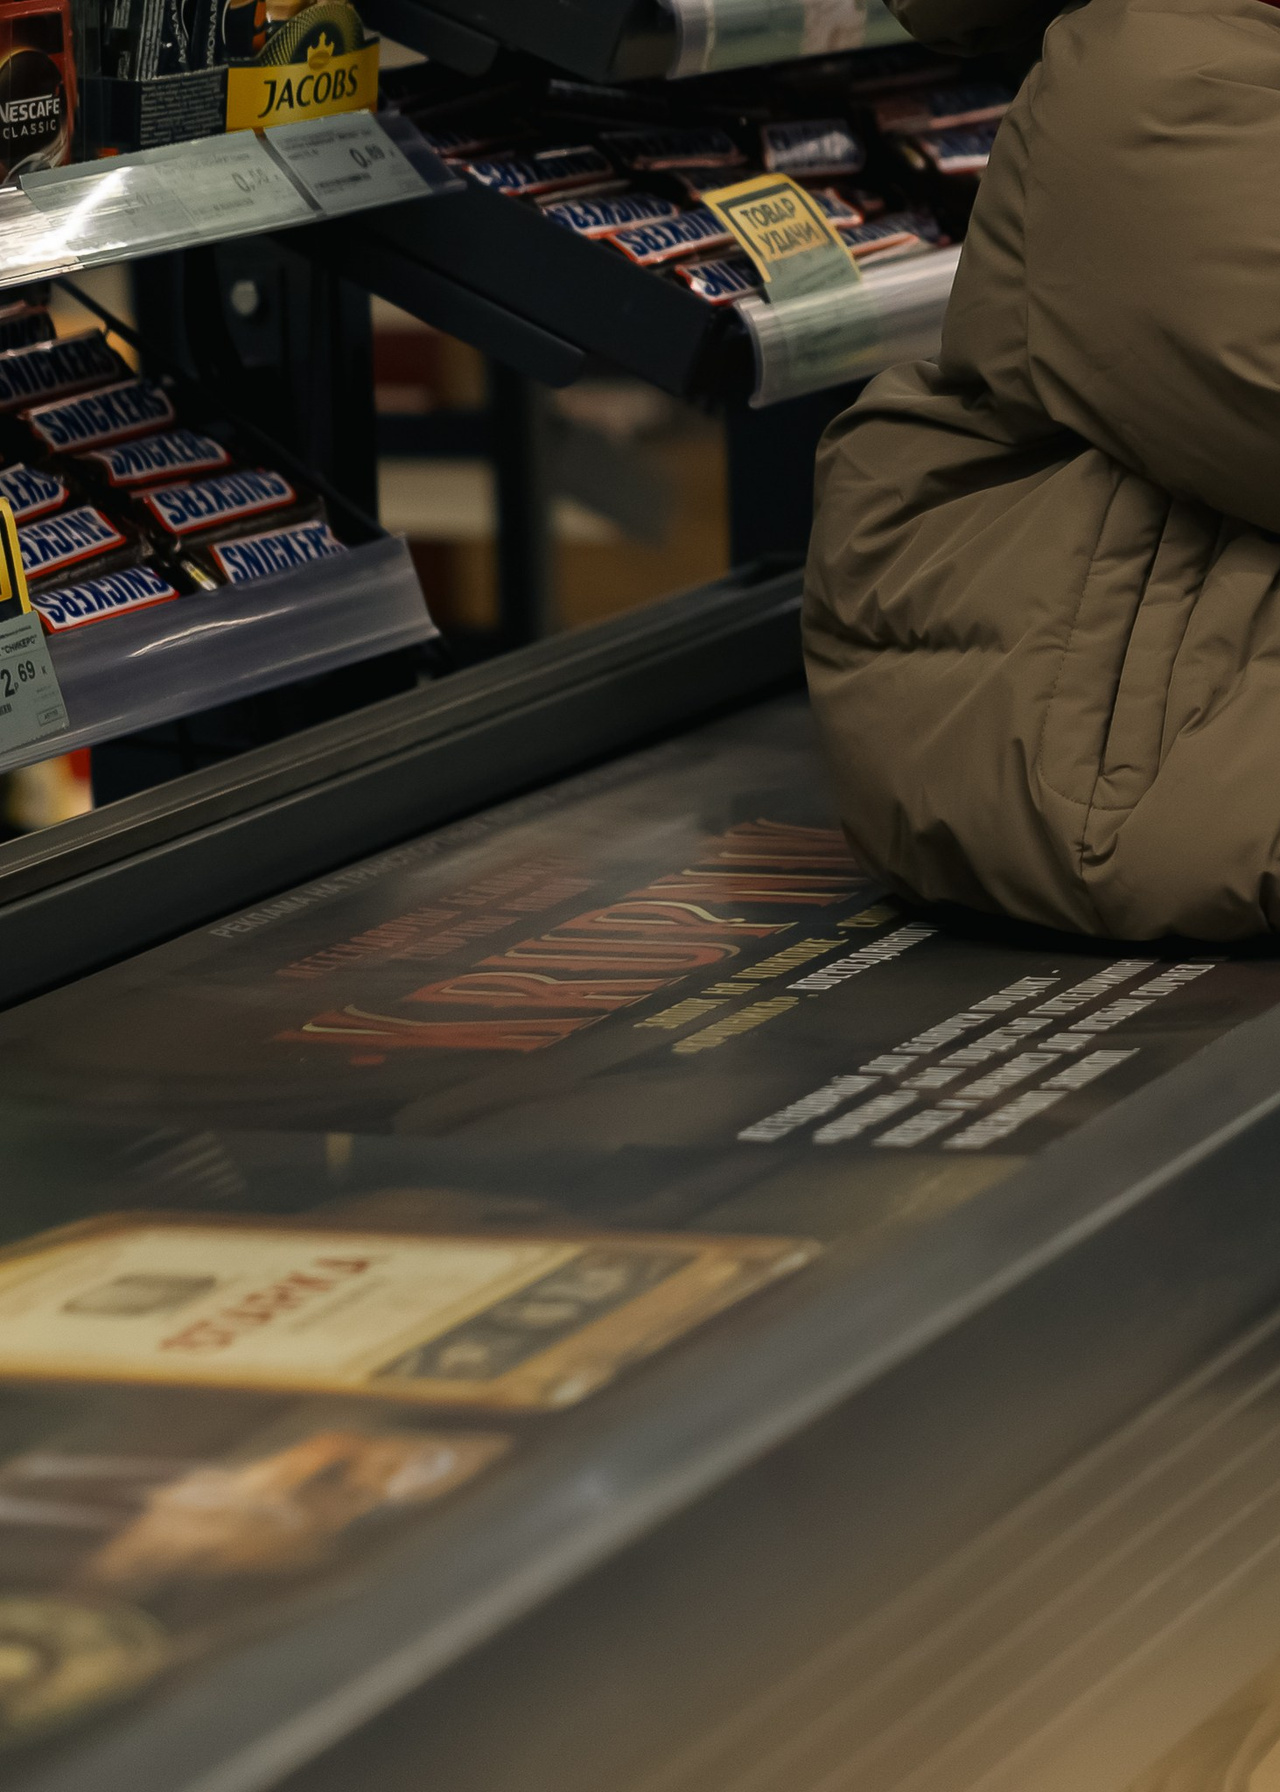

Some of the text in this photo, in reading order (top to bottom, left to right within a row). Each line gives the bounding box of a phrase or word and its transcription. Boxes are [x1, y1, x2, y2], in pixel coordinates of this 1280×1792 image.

[257, 65, 358, 119] JACOBS
[3, 119, 56, 139] CLASSIC
[740, 198, 797, 228] ТОВАР
[758, 221, 822, 255] УДАЧИ
[34, 385, 169, 446] SNICKERS
[156, 470, 287, 526] SNICKERS
[32, 566, 172, 623] SNICKERS
[210, 894, 312, 939] РЕКЛАМА
[634, 997, 730, 1029] ЗАМОК
[701, 982, 760, 994] НА
[969, 976, 1061, 1011] ПРОДУКТ
[1029, 958, 1160, 1015] ГОСТЕПРИИМНЫ
[1068, 998, 1158, 1032] ОСОБЫХ
[1129, 963, 1216, 997] СЛУЧАЕВ
